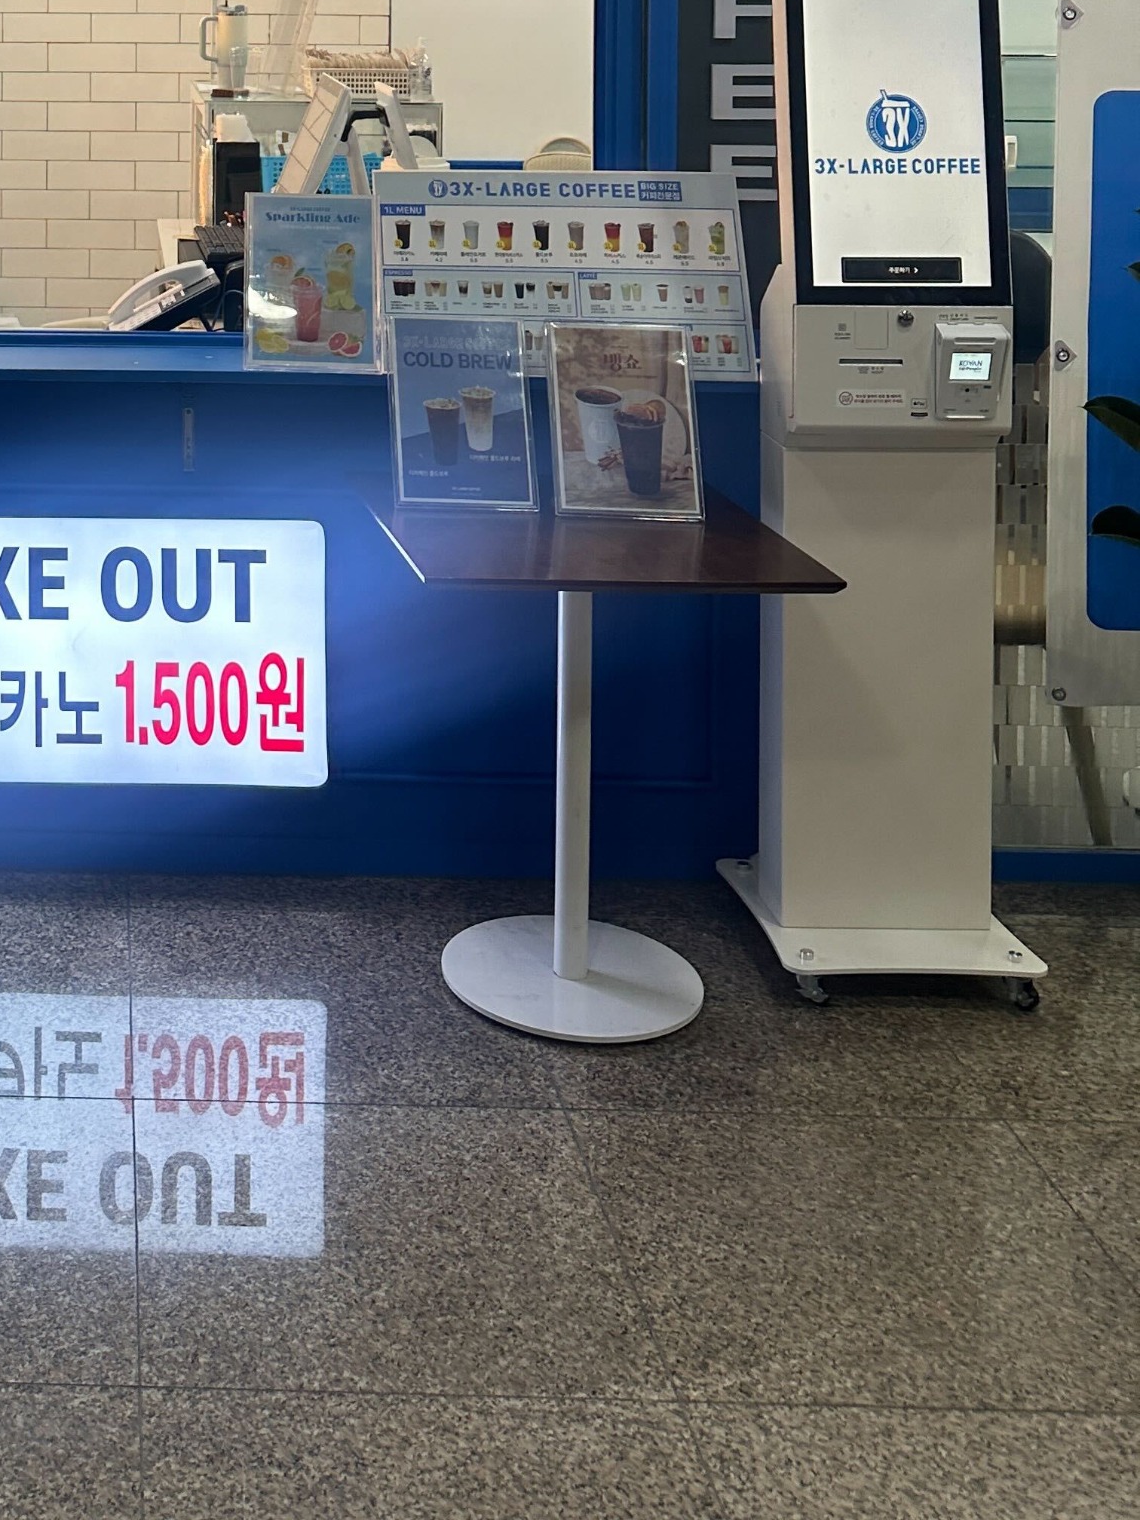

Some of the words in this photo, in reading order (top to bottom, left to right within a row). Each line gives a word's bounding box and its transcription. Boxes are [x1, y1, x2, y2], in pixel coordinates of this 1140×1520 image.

[815, 158, 907, 174] 3X-LARGE
[912, 158, 981, 174] COFFEE
[450, 181, 551, 197] 3X-LARGE
[558, 183, 636, 198] COFFEE
[265, 212, 331, 224] Sparkling
[333, 212, 361, 224] Ade
[396, 206, 423, 215] MENU
[403, 351, 454, 368] COLD
[458, 353, 512, 370] BREW
[100, 546, 267, 623] OUT
[115, 651, 306, 753] 1.500원
